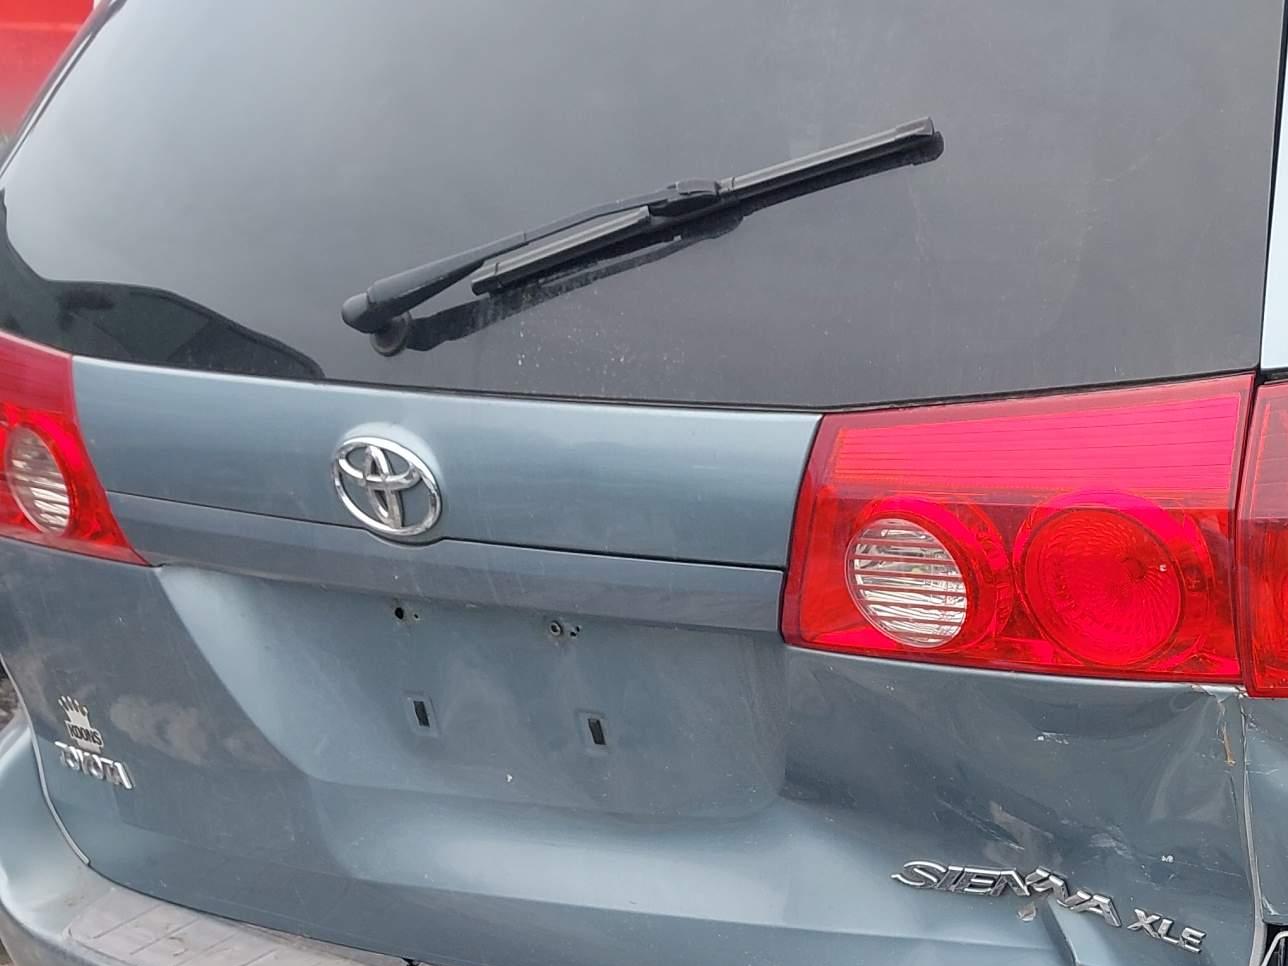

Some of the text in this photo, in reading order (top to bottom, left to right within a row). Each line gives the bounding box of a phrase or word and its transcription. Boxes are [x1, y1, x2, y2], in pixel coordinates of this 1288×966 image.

[69, 723, 103, 747] KOONS
[54, 741, 134, 790] TOYOTA
[890, 860, 1207, 953] SIENNA XLE
